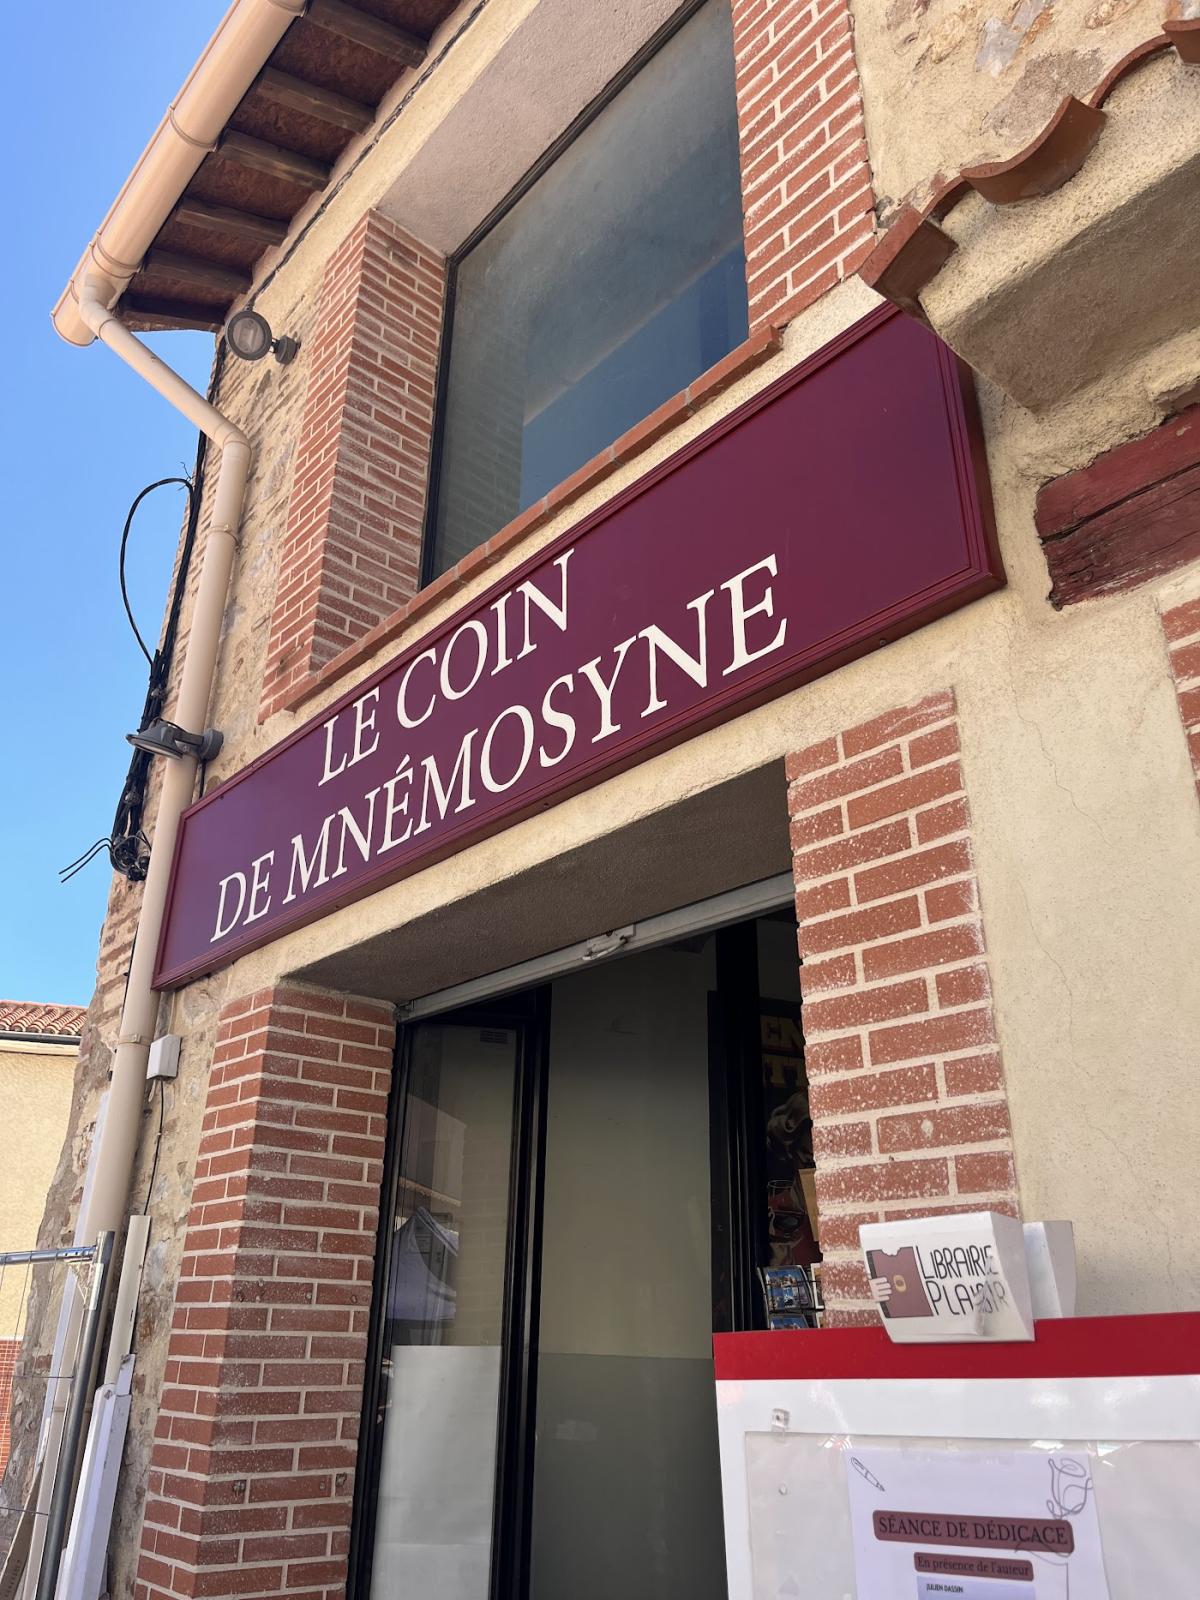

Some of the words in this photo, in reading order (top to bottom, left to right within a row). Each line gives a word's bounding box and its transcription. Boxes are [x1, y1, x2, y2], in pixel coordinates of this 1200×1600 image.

[318, 686, 380, 786] LE
[396, 548, 575, 729] COIN
[210, 850, 275, 943] DE
[282, 553, 788, 905] MNÉMOSYNE
[878, 1514, 942, 1537] SÉANCE
[946, 1521, 967, 1538] DE
[975, 1519, 1068, 1545] DÉDICACE
[917, 1557, 930, 1568] En
[932, 1558, 974, 1571] présence
[977, 1560, 988, 1572] de
